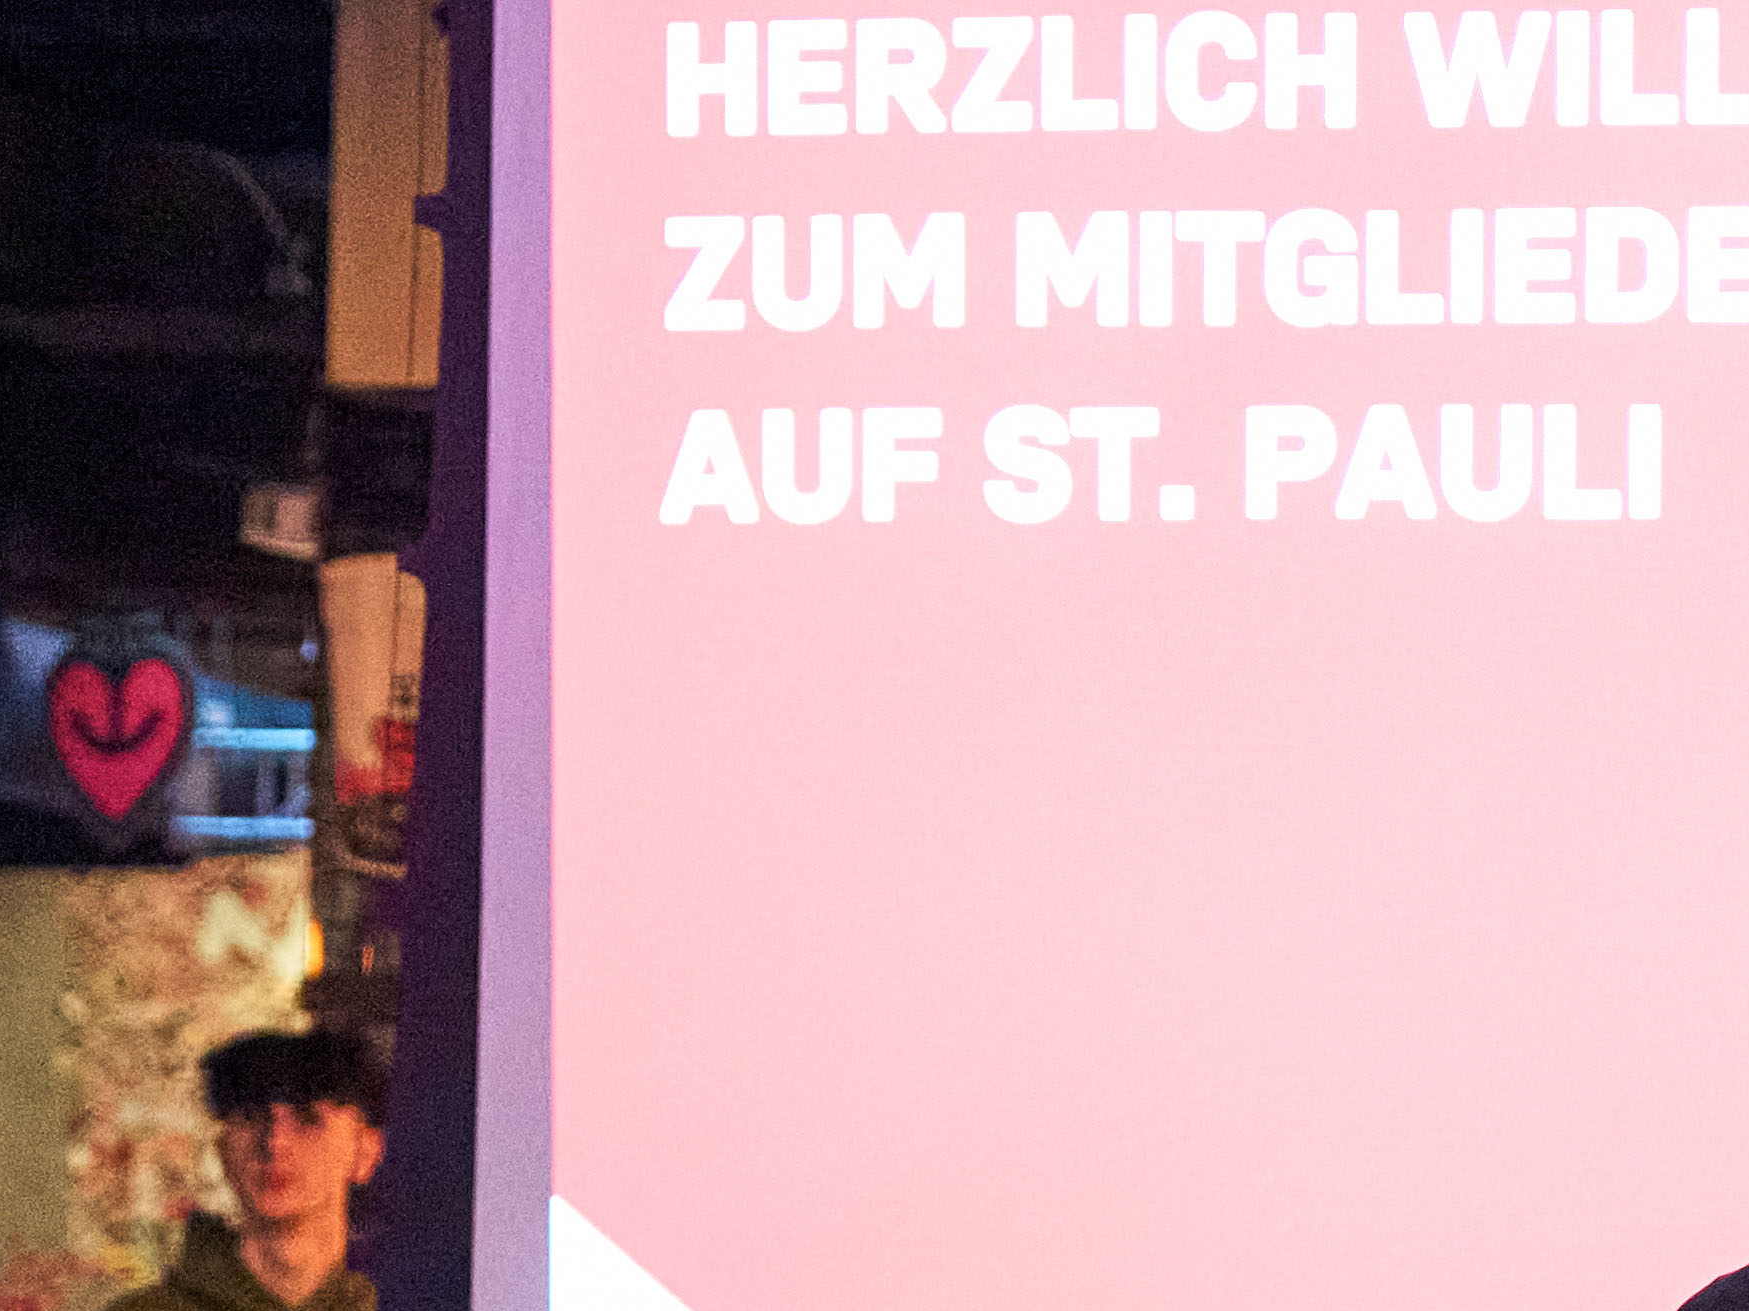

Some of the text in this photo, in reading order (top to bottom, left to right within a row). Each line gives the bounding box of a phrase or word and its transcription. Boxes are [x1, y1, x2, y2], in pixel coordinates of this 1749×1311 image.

[664, 9, 1358, 139] HERZLICH
[663, 211, 966, 333] ZUM
[658, 402, 1663, 526] AUF ST. PAULI
